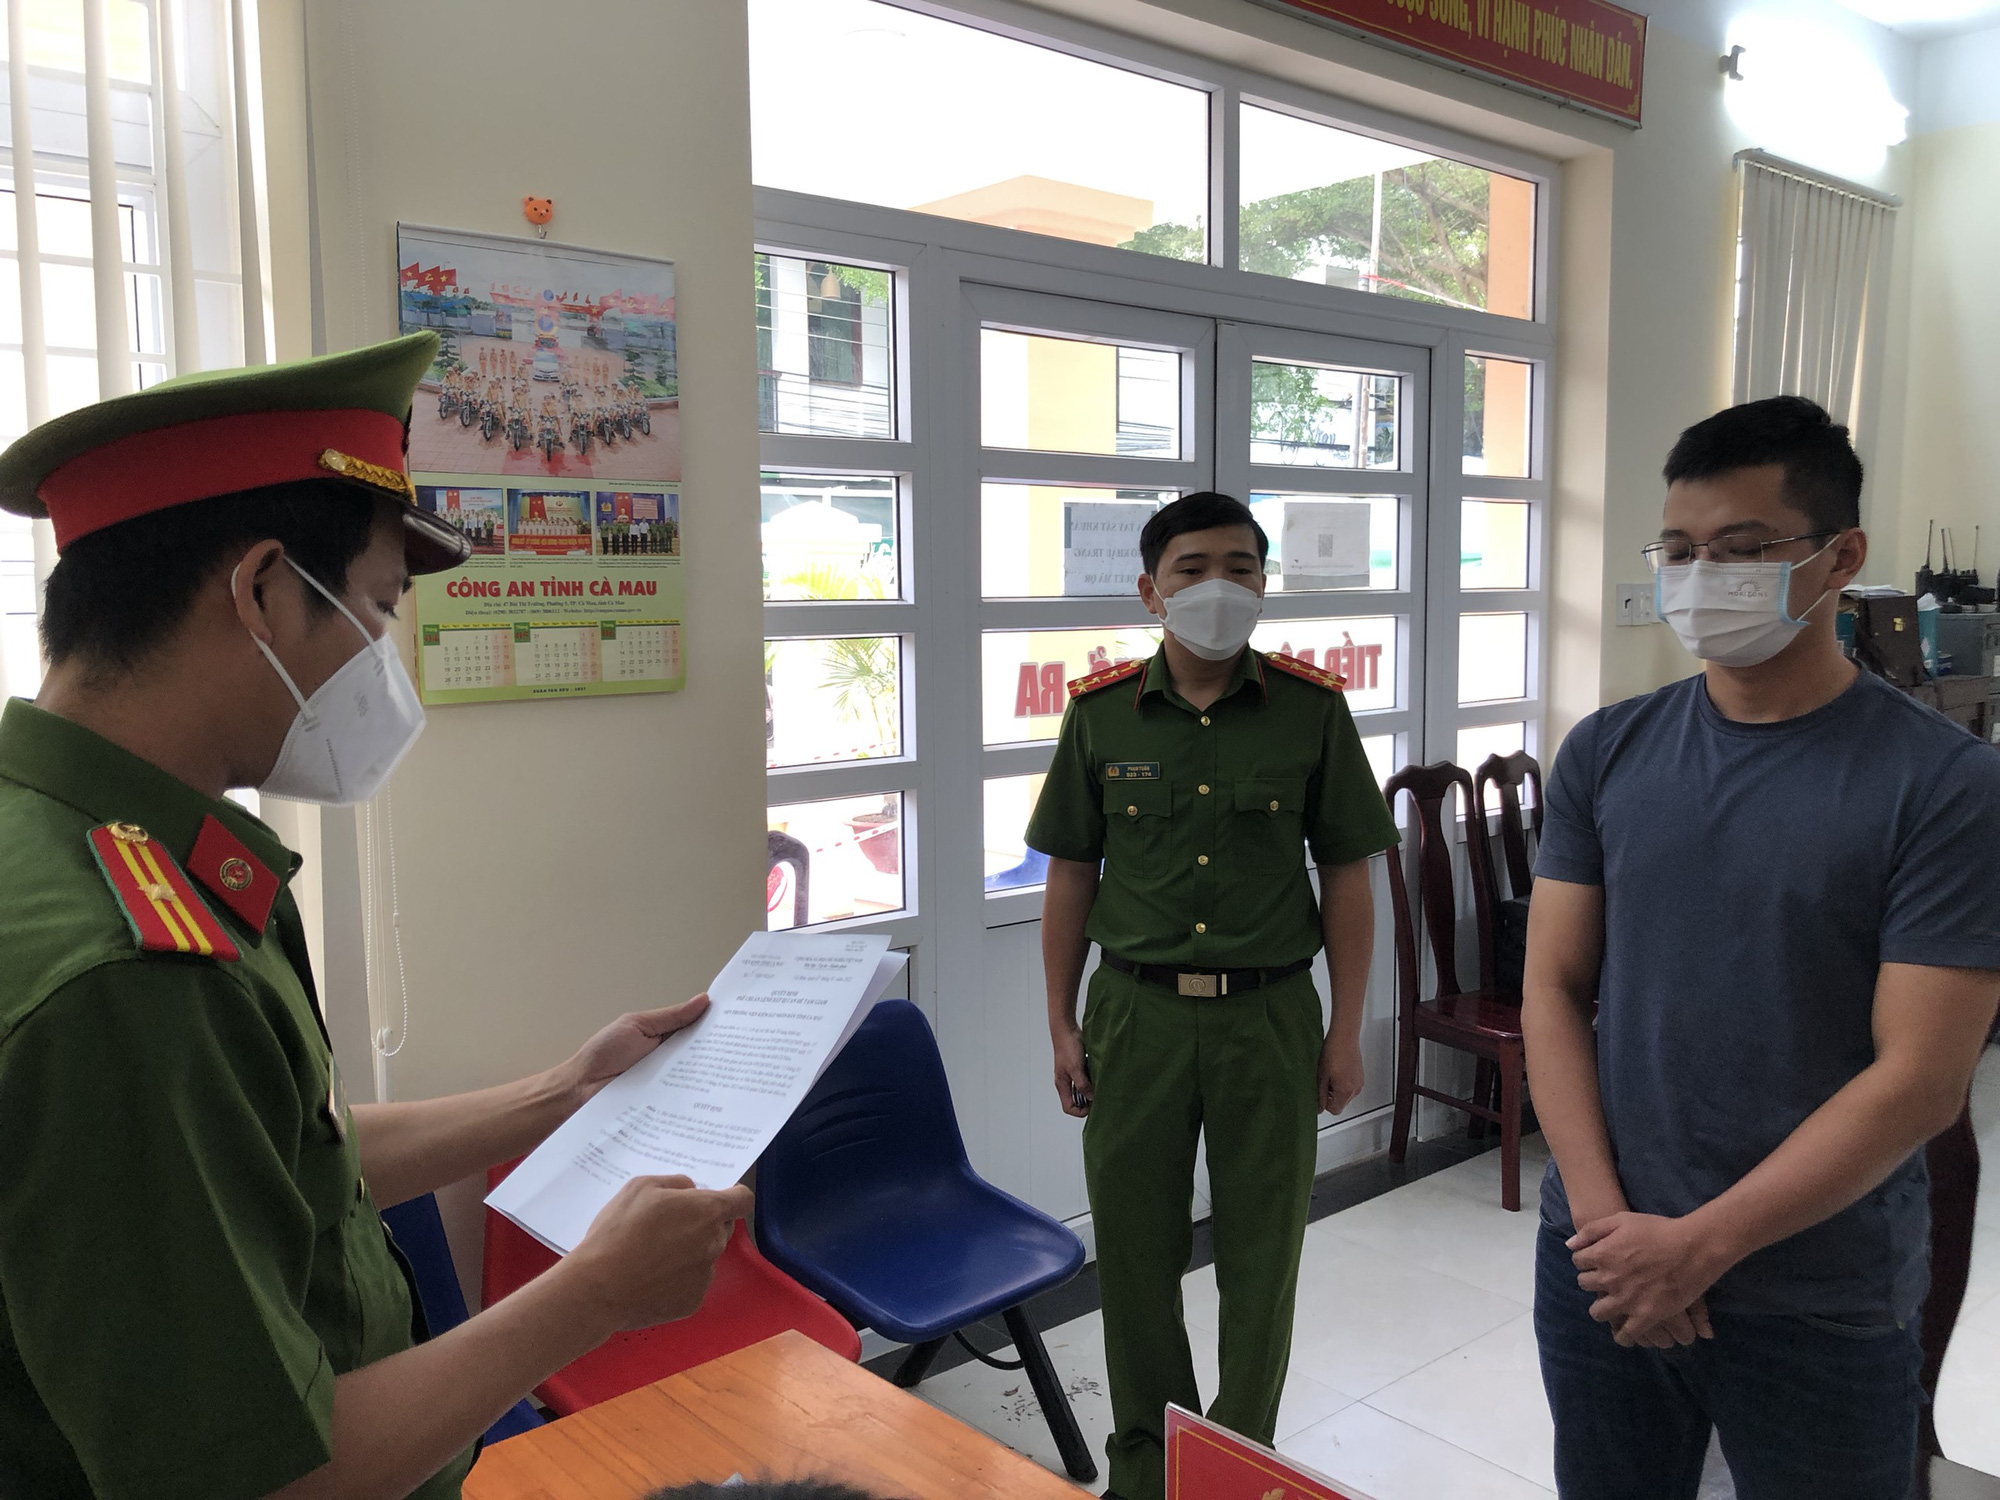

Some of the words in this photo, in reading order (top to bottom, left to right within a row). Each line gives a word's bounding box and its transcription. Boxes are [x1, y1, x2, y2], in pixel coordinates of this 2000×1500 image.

[1493, 0, 1530, 58] HẠNH
[1532, 6, 1567, 66] PHÚC
[1569, 20, 1604, 80] NHÂN
[446, 576, 500, 598] CÔNG
[506, 581, 535, 597] AN
[540, 576, 584, 596] TỈNH
[589, 576, 614, 596] CÀ
[618, 580, 657, 596] MAU
